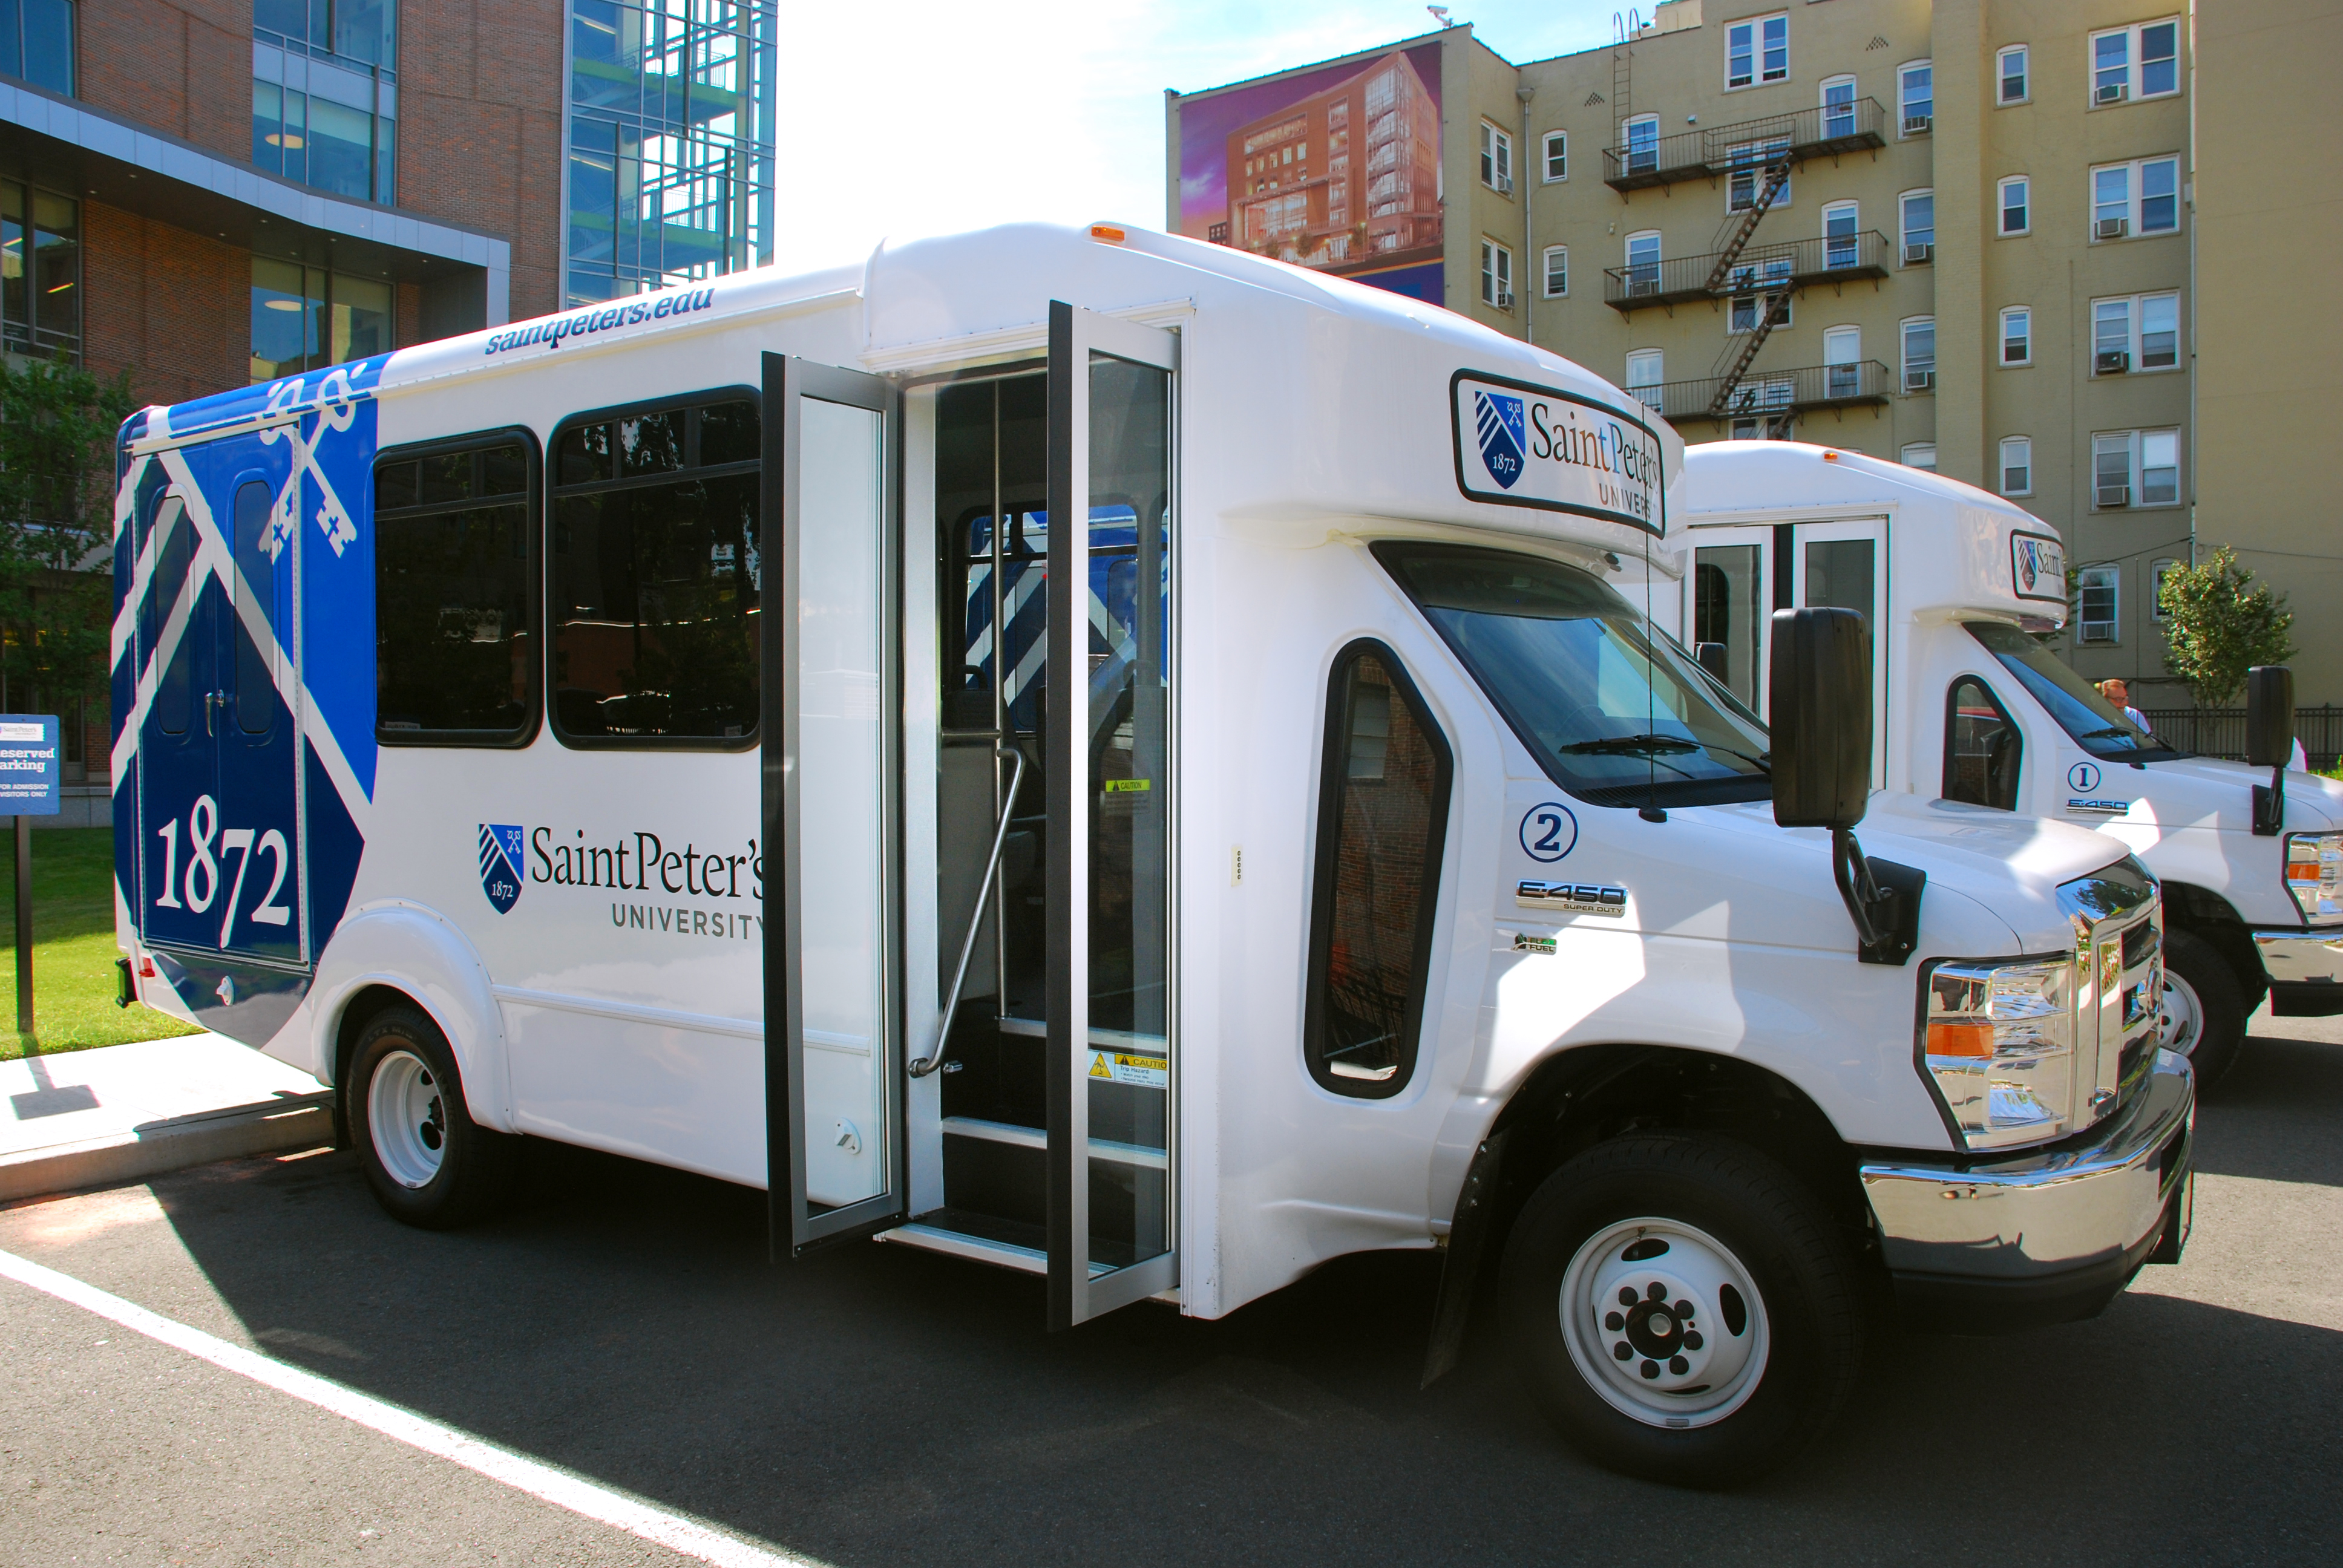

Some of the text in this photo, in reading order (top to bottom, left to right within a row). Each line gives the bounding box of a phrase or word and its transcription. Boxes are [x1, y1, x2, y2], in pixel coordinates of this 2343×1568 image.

[485, 287, 715, 354] saintpeters.edu
[1492, 453, 1516, 474] 1872
[0, 748, 55, 759] eserved
[0, 759, 46, 773] arking
[2079, 768, 2089, 786] 1
[1533, 814, 1562, 851] 2
[156, 794, 290, 948] 1872
[491, 881, 513, 898] 1872
[1133, 1058, 1167, 1069] CAUTIO
